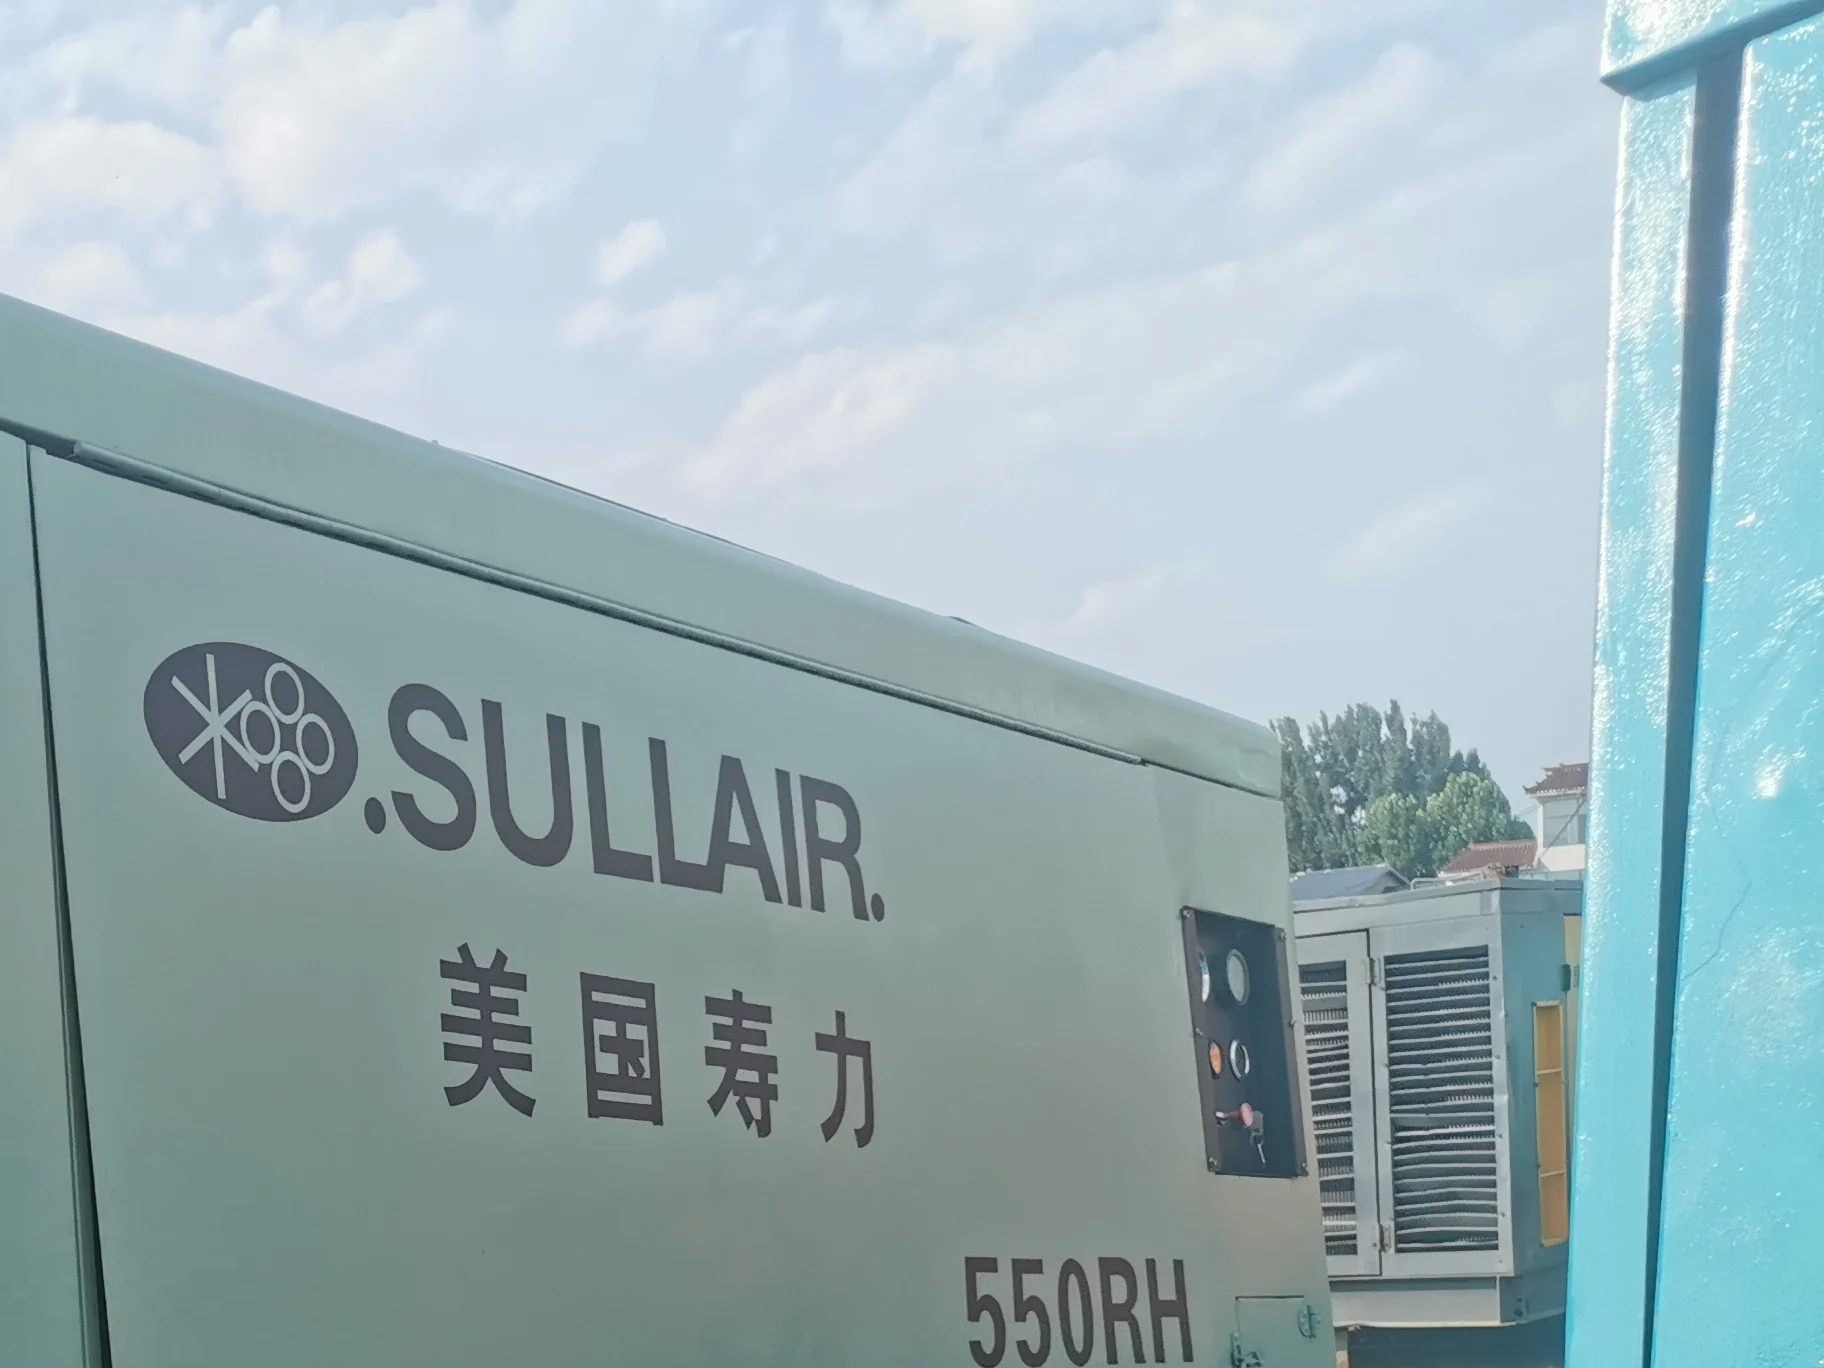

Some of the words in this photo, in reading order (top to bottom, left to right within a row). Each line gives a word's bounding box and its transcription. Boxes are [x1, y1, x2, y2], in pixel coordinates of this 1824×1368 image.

[439, 942, 876, 1149] 美国寿力
[964, 1256, 1194, 1368] 550RH
